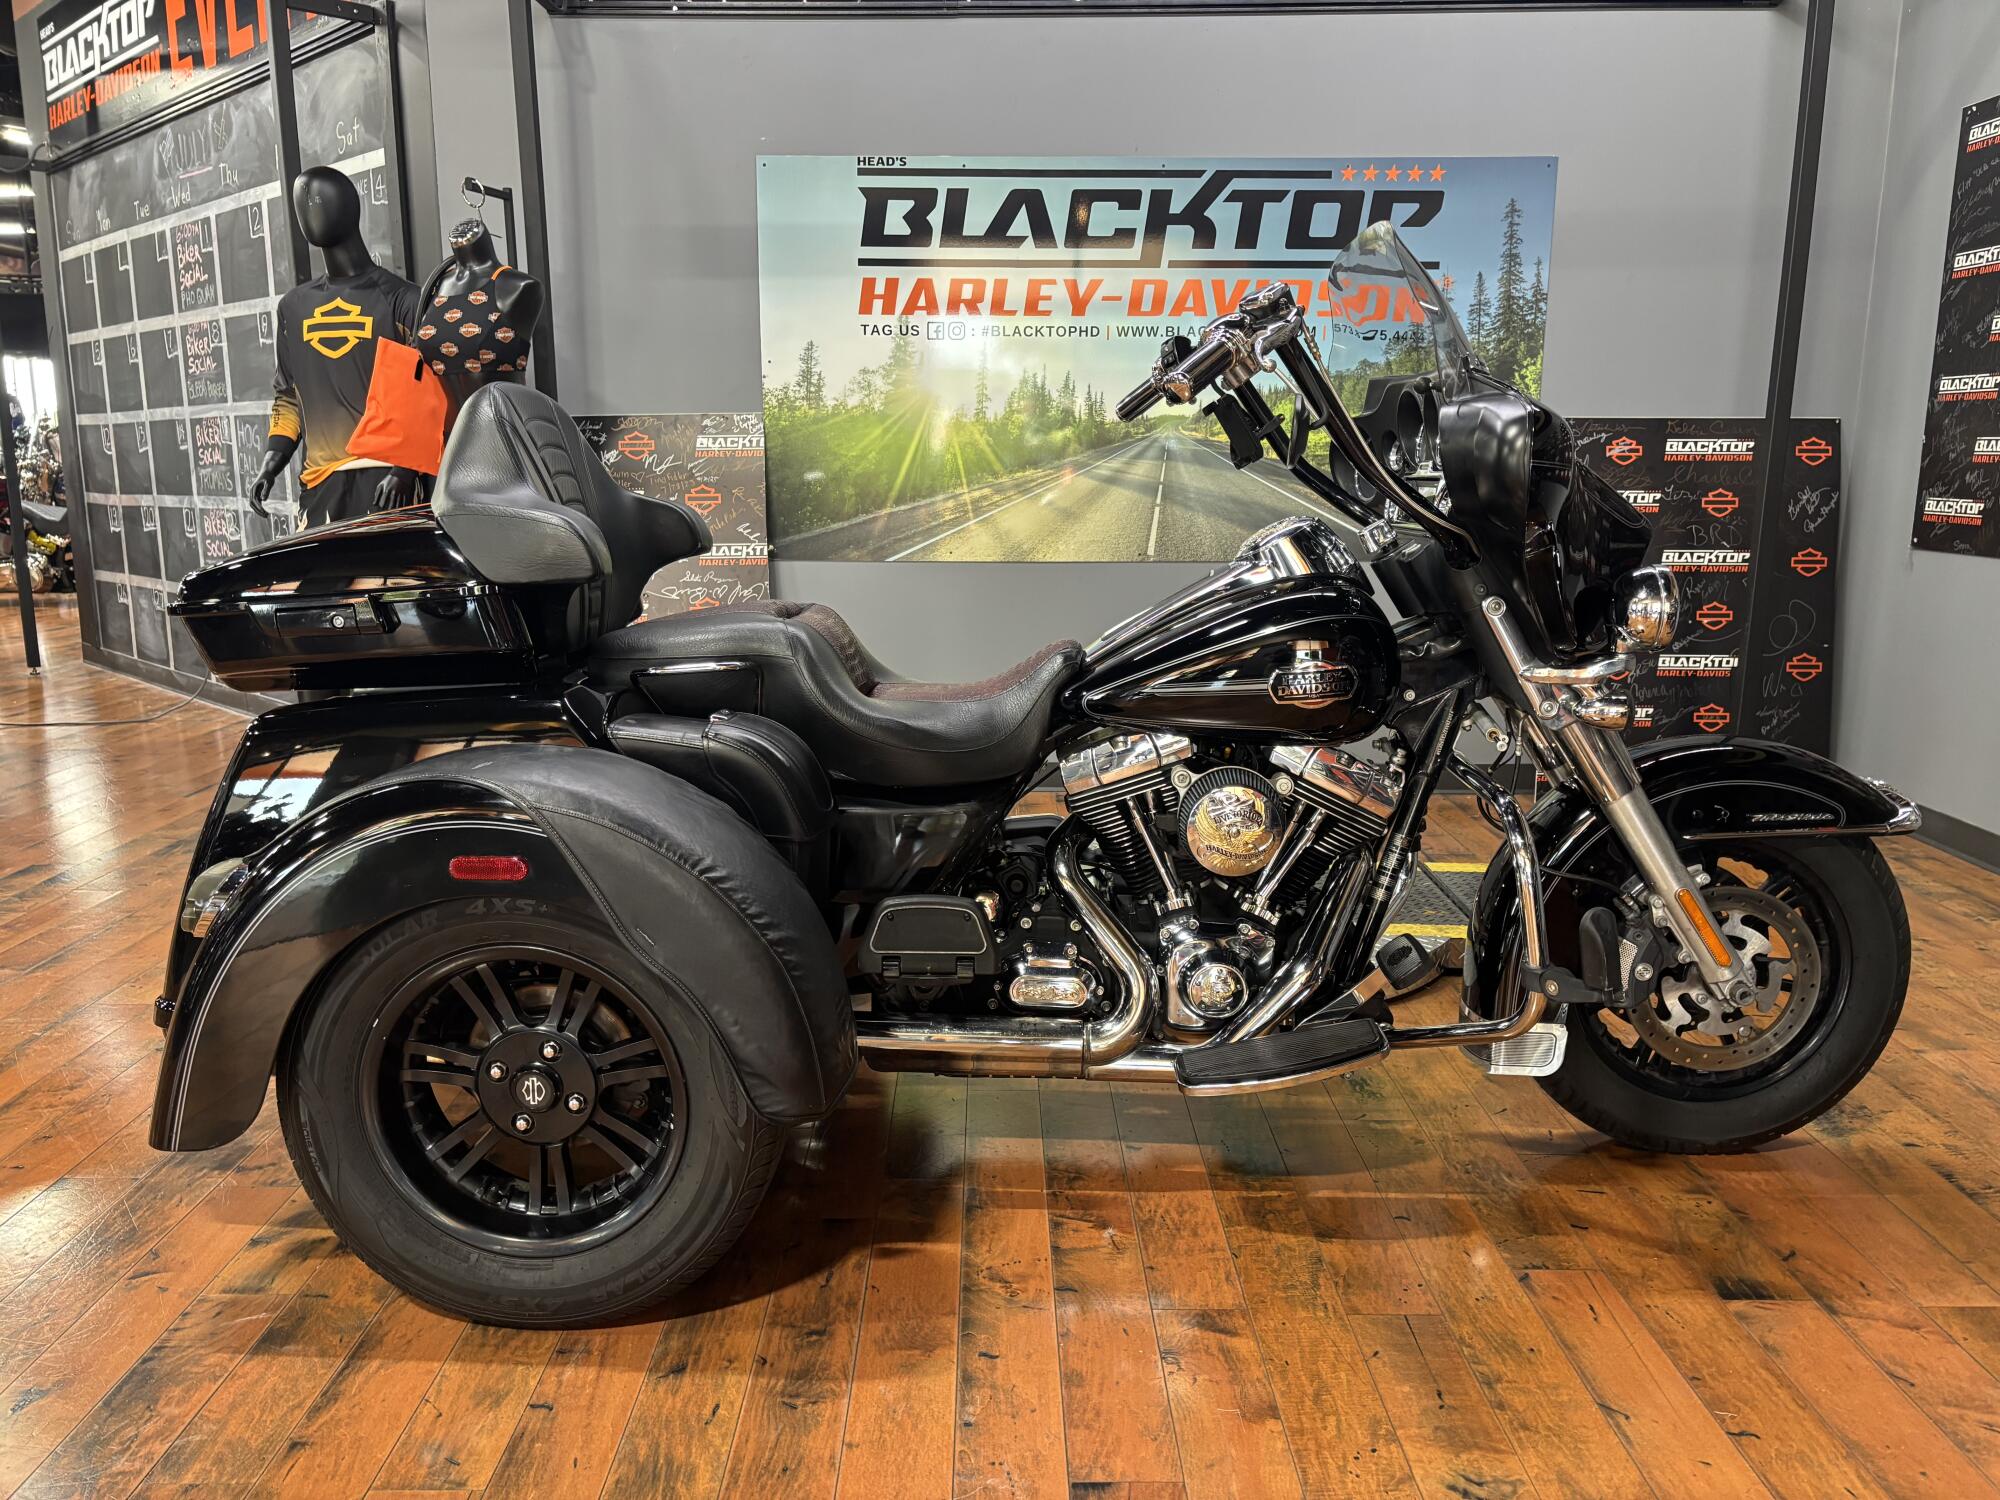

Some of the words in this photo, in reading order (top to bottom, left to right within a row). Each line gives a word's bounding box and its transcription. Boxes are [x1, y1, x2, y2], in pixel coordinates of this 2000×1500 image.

[336, 117, 360, 154] Sat
[856, 156, 908, 168] HEAD'S
[170, 181, 191, 208] Wed
[219, 162, 239, 187] Thu
[252, 206, 261, 231] 2
[858, 180, 1445, 258] BLACKTOP
[211, 321, 220, 343] 8
[261, 314, 268, 337] 9
[860, 324, 893, 337] TAG
[899, 324, 920, 337] US
[981, 324, 1100, 338] #BLACKTOPHD
[1940, 375, 2000, 391] BLACKTOP
[1936, 391, 1998, 402] HARLEY-DAVIDSON
[237, 419, 261, 452] HOG
[1665, 440, 1755, 453] BLACKTOP
[1664, 454, 1753, 462] HARLEY-DAVIDSON
[1924, 500, 1984, 515] BLACKTOP
[1922, 514, 1982, 526] HARLEY-DAVIDSON
[1661, 551, 1750, 564] BLACKTOP
